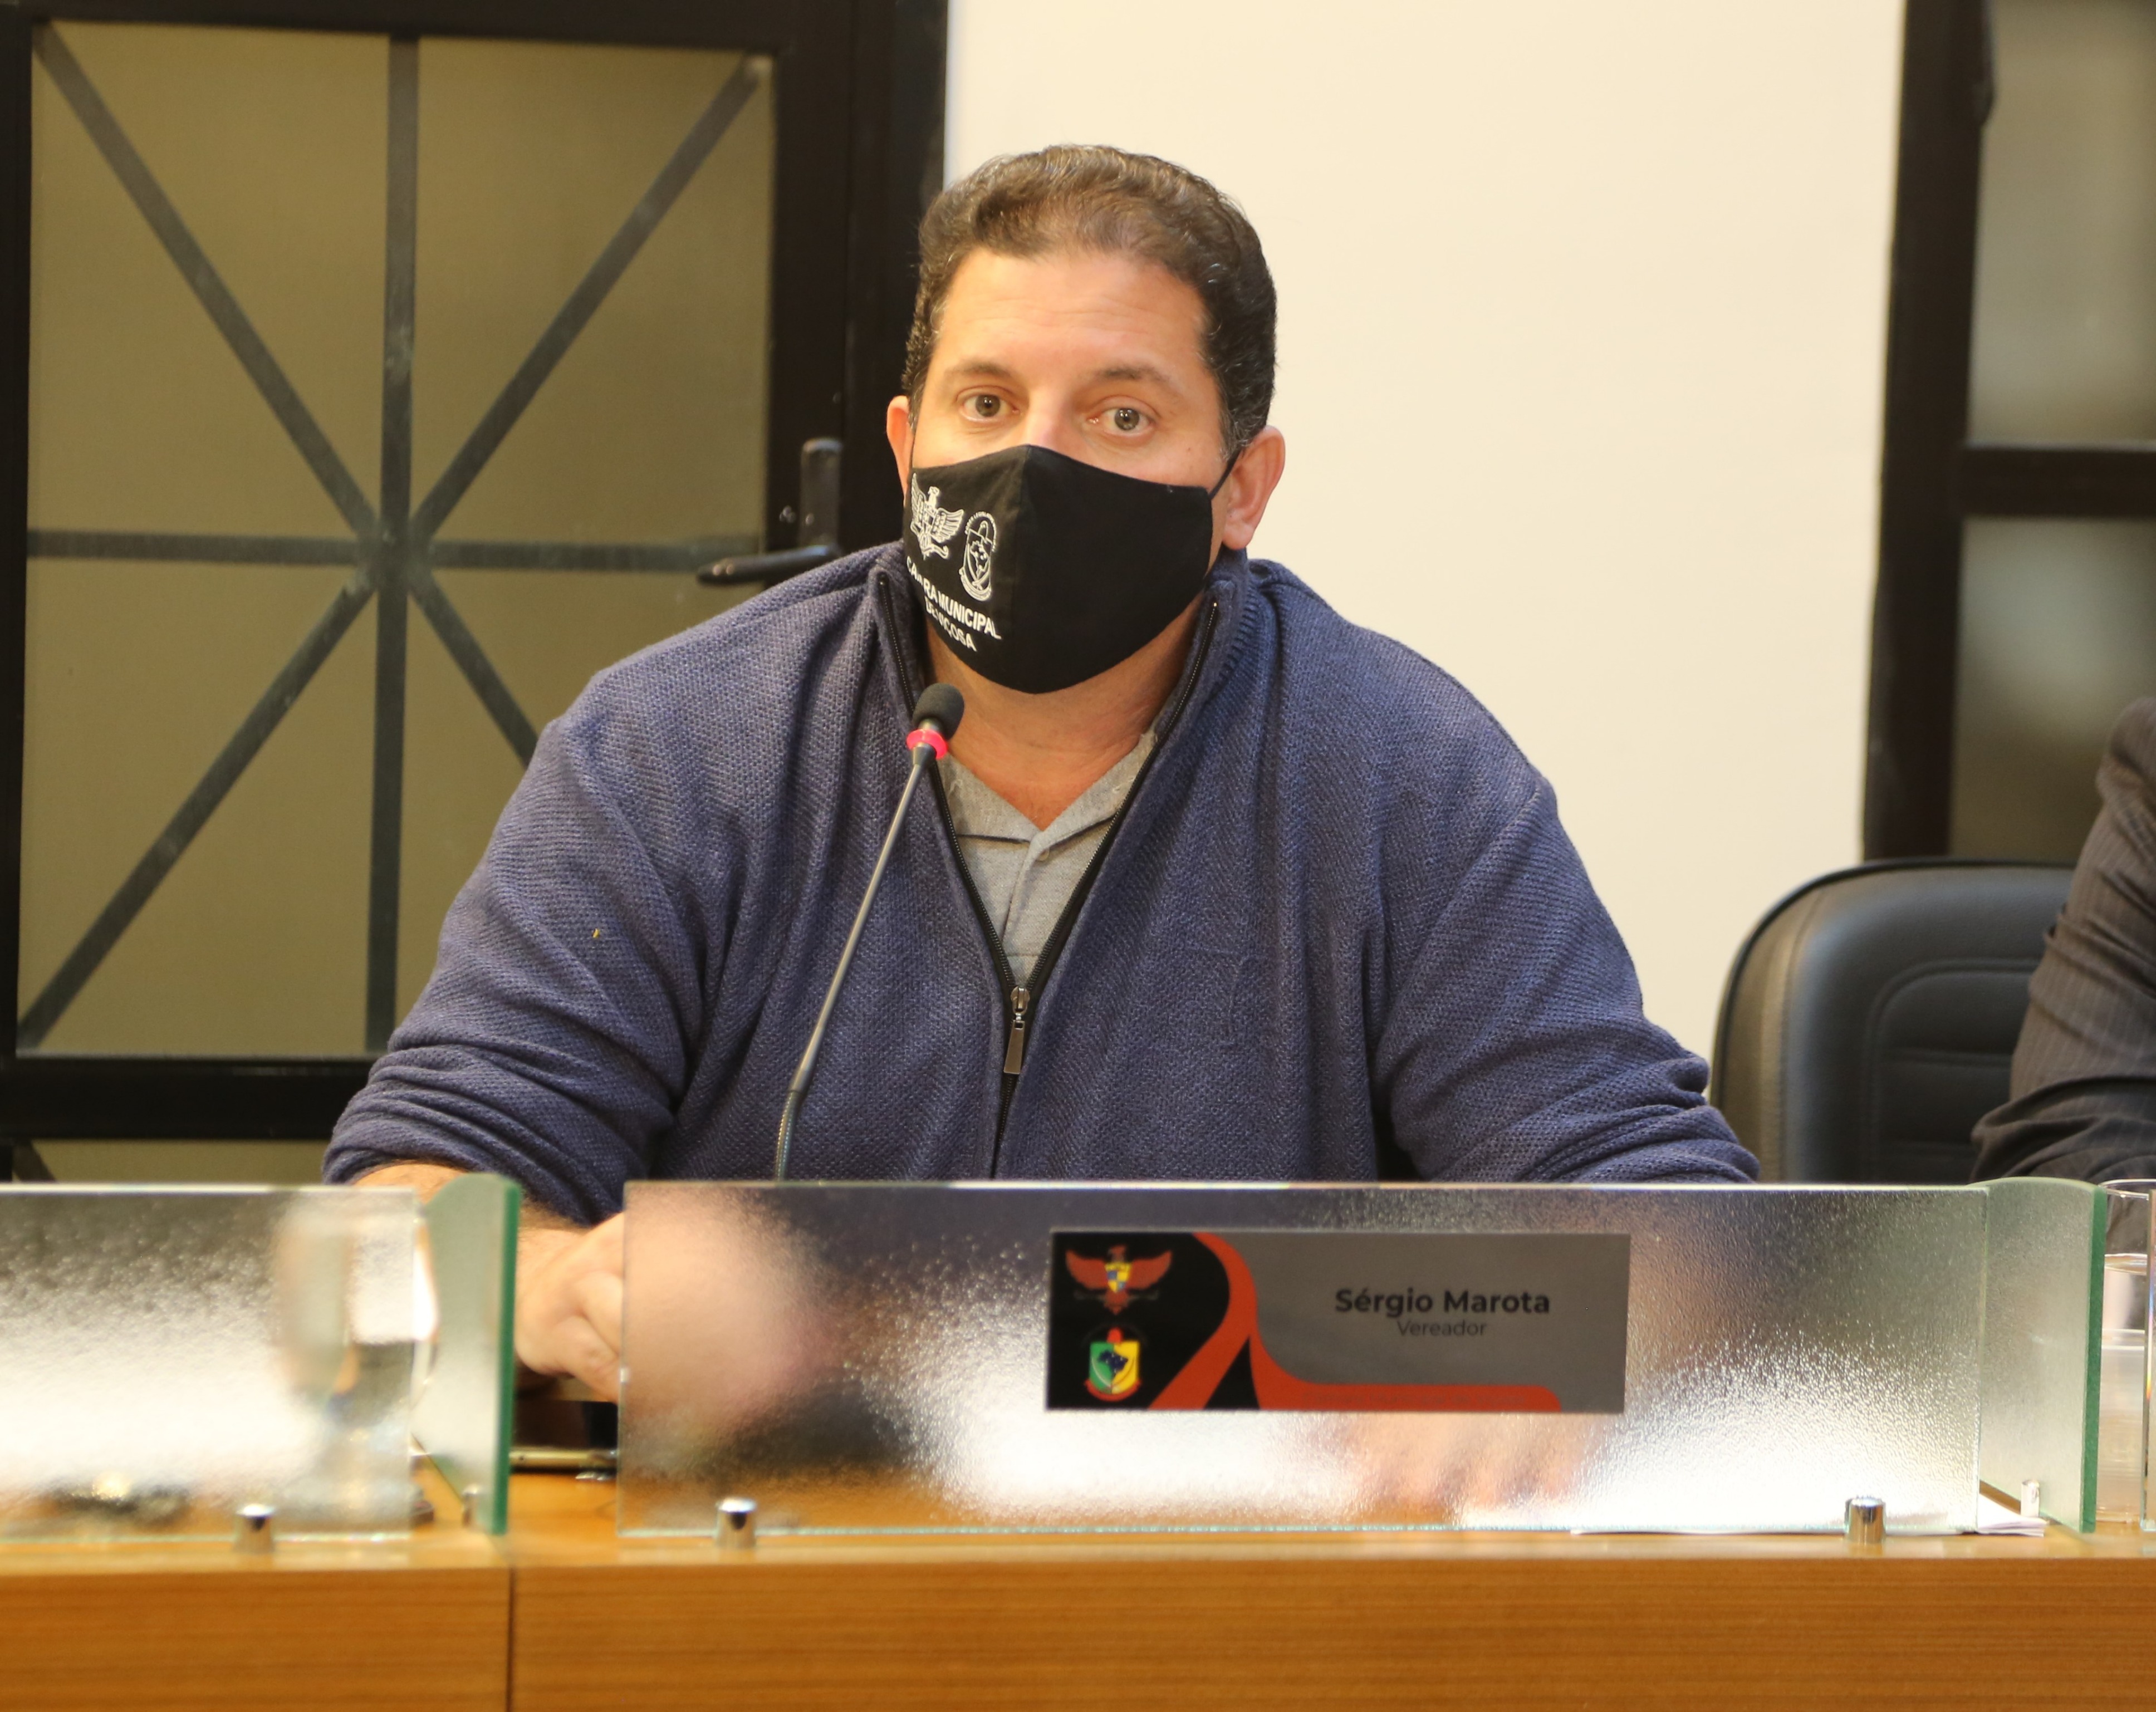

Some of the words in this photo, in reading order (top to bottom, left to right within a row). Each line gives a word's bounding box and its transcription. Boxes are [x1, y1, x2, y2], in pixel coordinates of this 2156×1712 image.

[937, 590, 1002, 640] MUNICIPAL
[1335, 1287, 1433, 1318] Sérgio
[1443, 1289, 1550, 1313] Marota
[1396, 1319, 1487, 1337] Vereador
